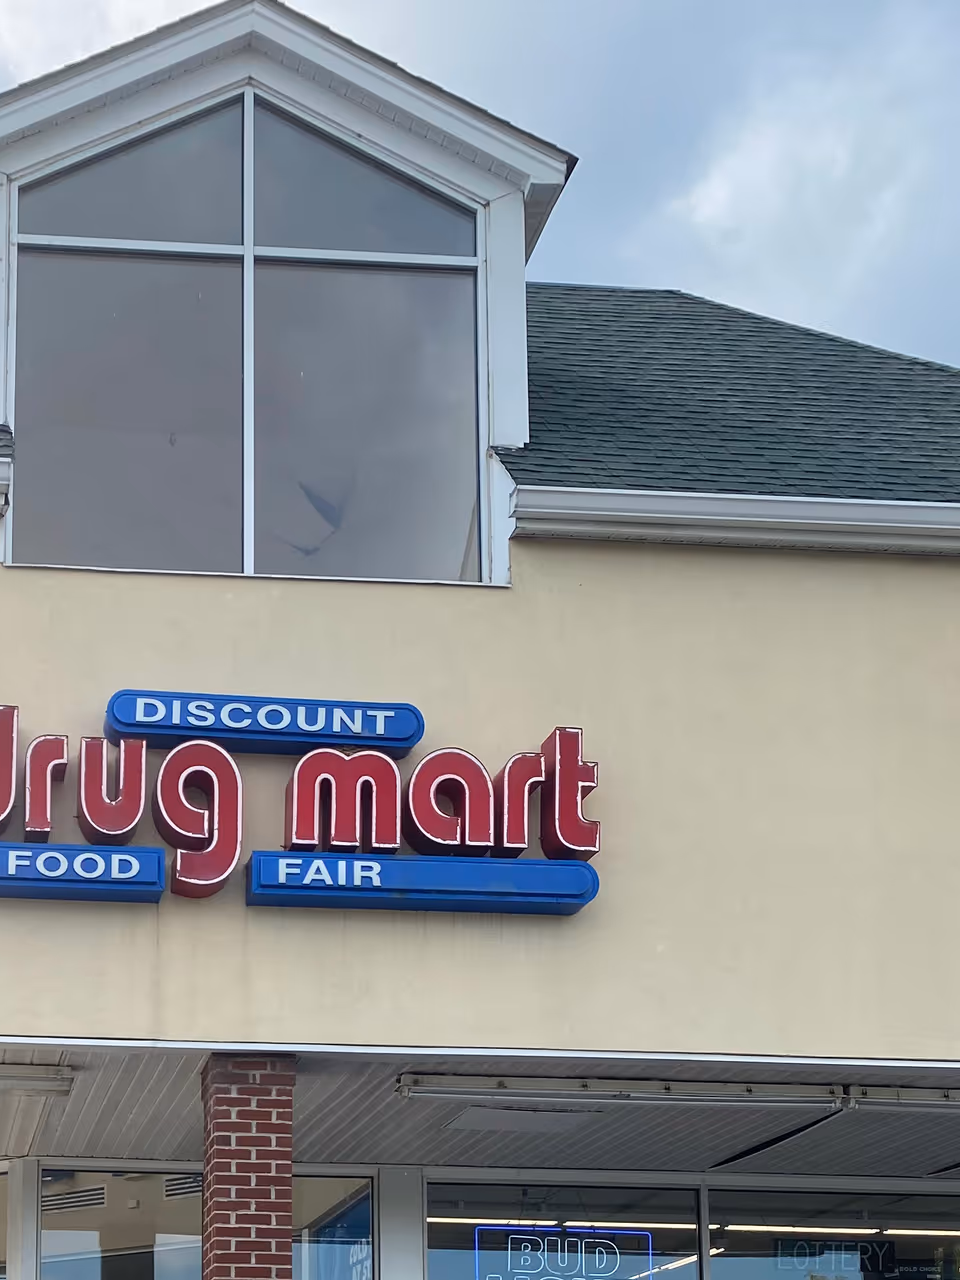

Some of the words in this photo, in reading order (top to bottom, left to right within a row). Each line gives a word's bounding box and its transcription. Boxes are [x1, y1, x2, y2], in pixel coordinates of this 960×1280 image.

[135, 698, 396, 736] DISCOUNT
[287, 726, 601, 858] mart
[7, 850, 141, 879] FOOD
[277, 858, 382, 887] FAIR
[507, 1234, 620, 1276] BUD
[777, 1240, 889, 1271] LOTTERY
